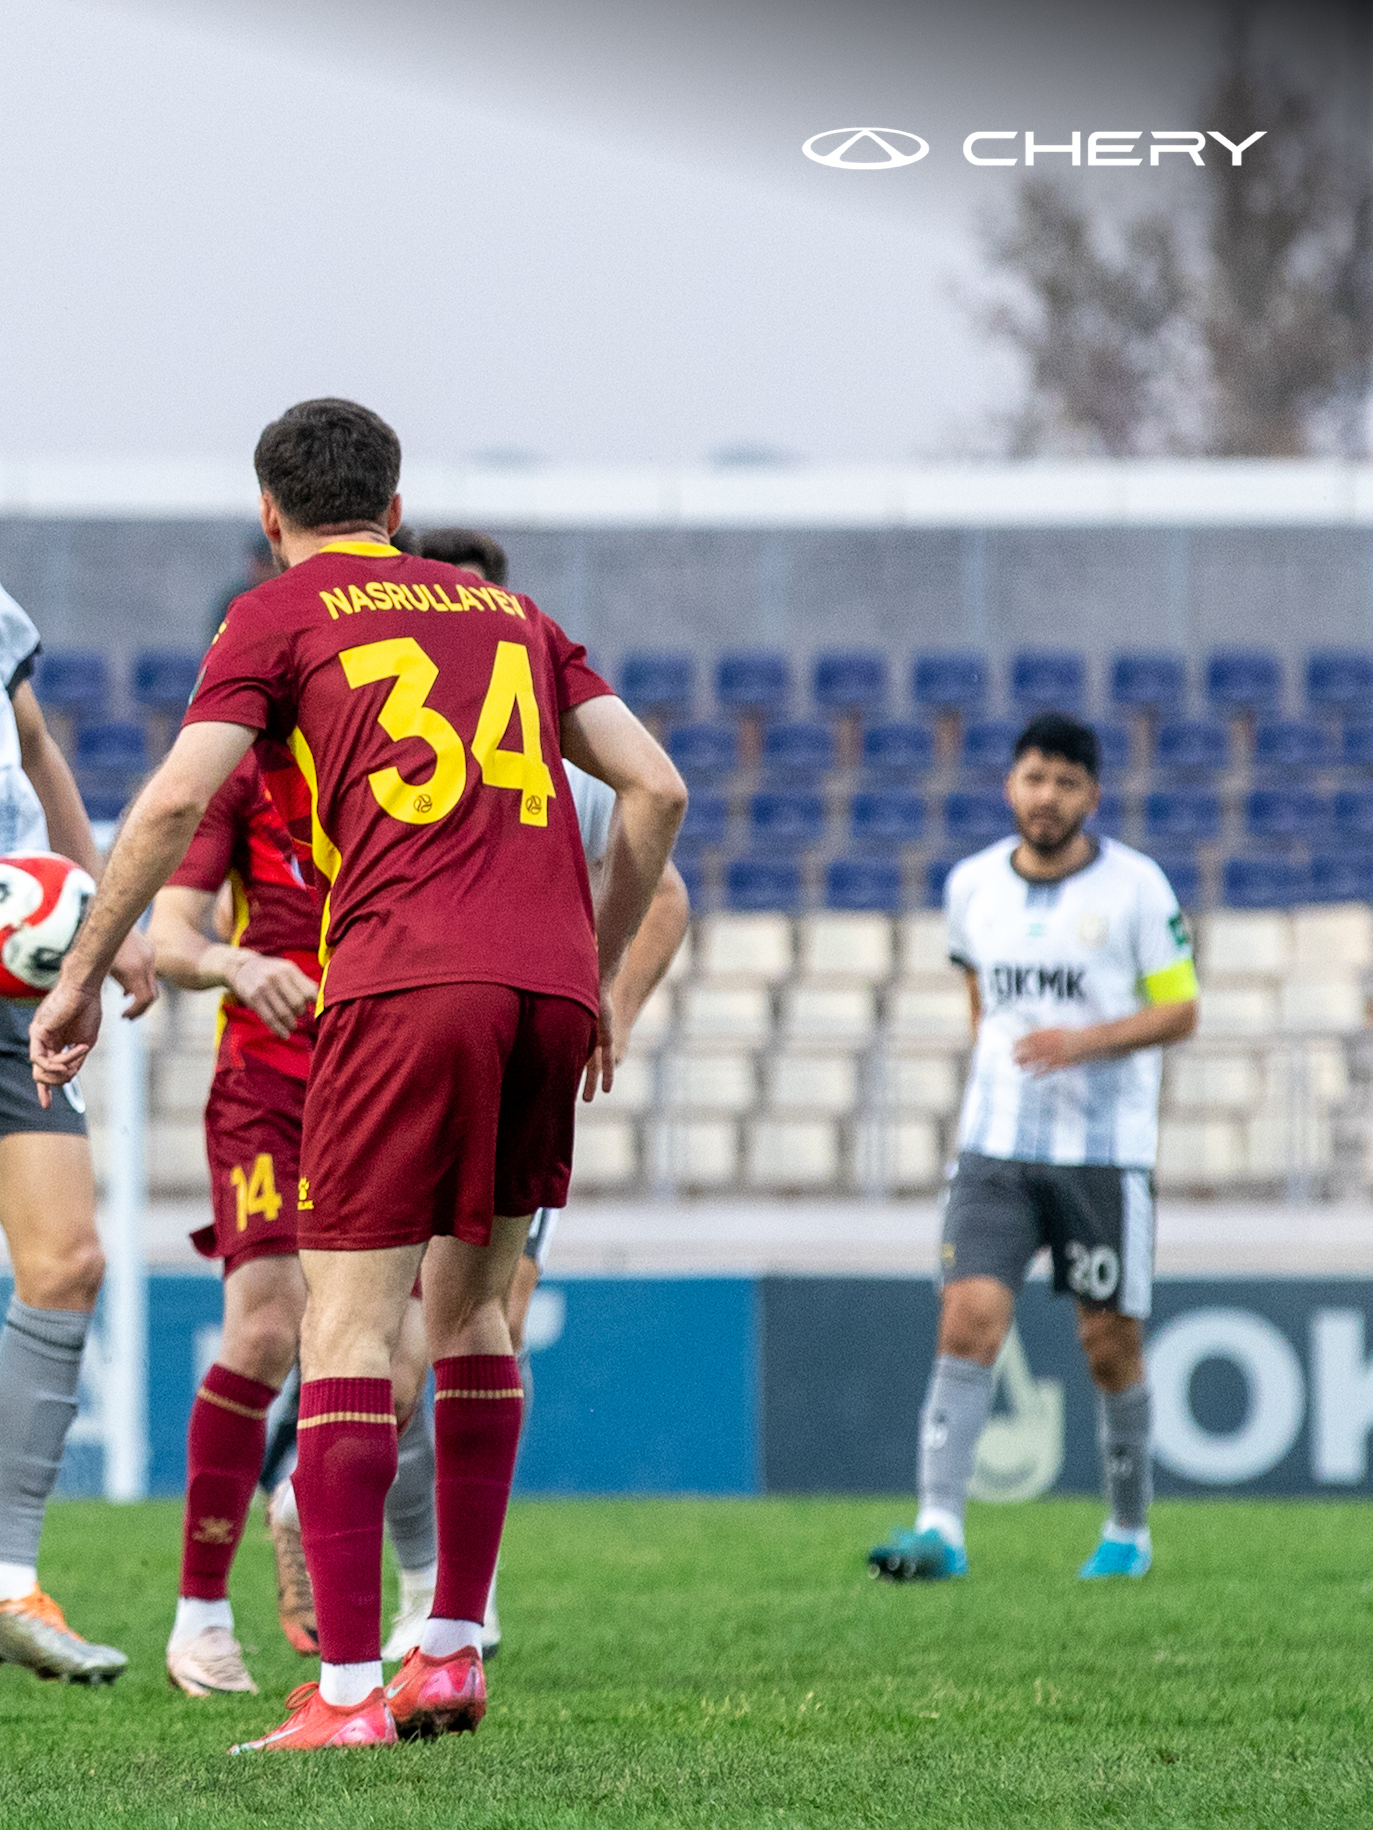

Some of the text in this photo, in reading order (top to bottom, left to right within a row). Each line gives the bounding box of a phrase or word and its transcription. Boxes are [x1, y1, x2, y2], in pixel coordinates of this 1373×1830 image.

[319, 581, 526, 621] NASRULLAYEV
[338, 637, 556, 827] 34
[992, 964, 1088, 1004] OKMK
[230, 1152, 283, 1233] 14
[1066, 1240, 1120, 1301] 20
